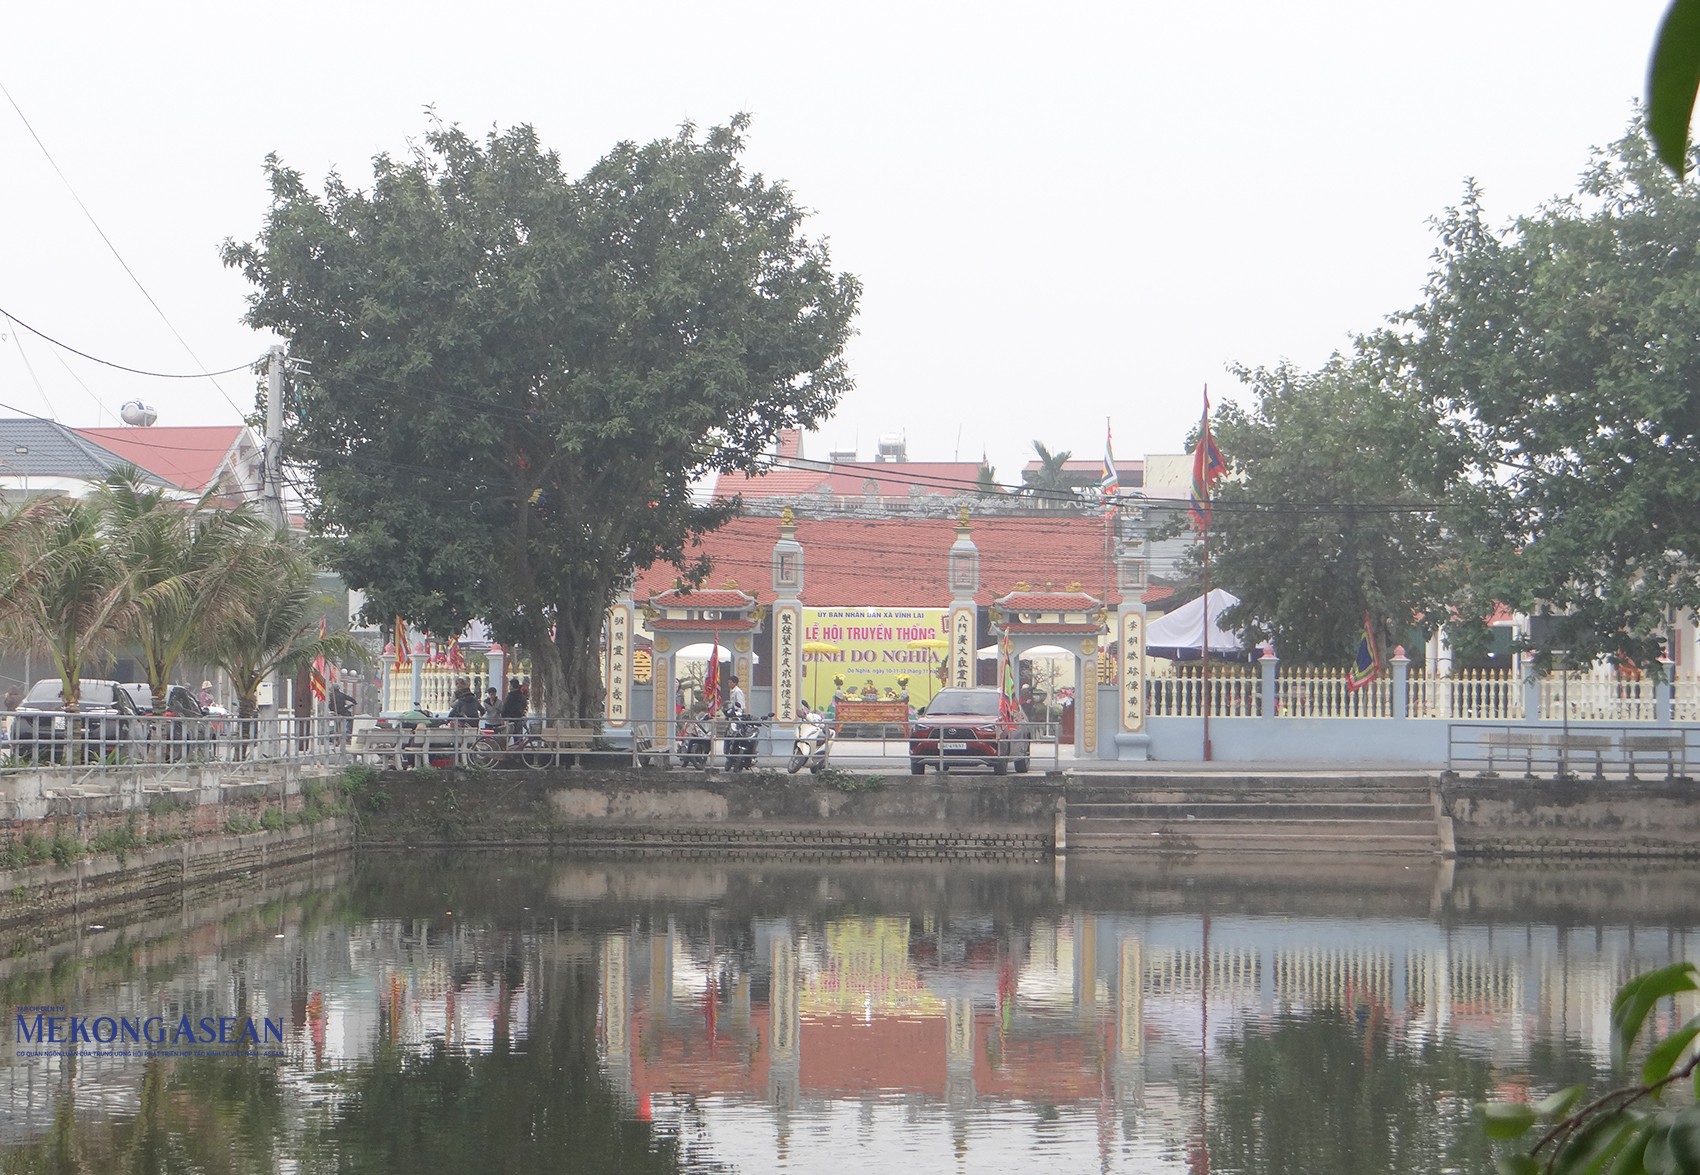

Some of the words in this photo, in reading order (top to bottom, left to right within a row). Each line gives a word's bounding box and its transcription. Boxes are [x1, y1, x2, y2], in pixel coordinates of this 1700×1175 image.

[805, 622, 819, 640] LỄ
[823, 624, 843, 643] HỘI
[850, 649, 877, 662] DO
